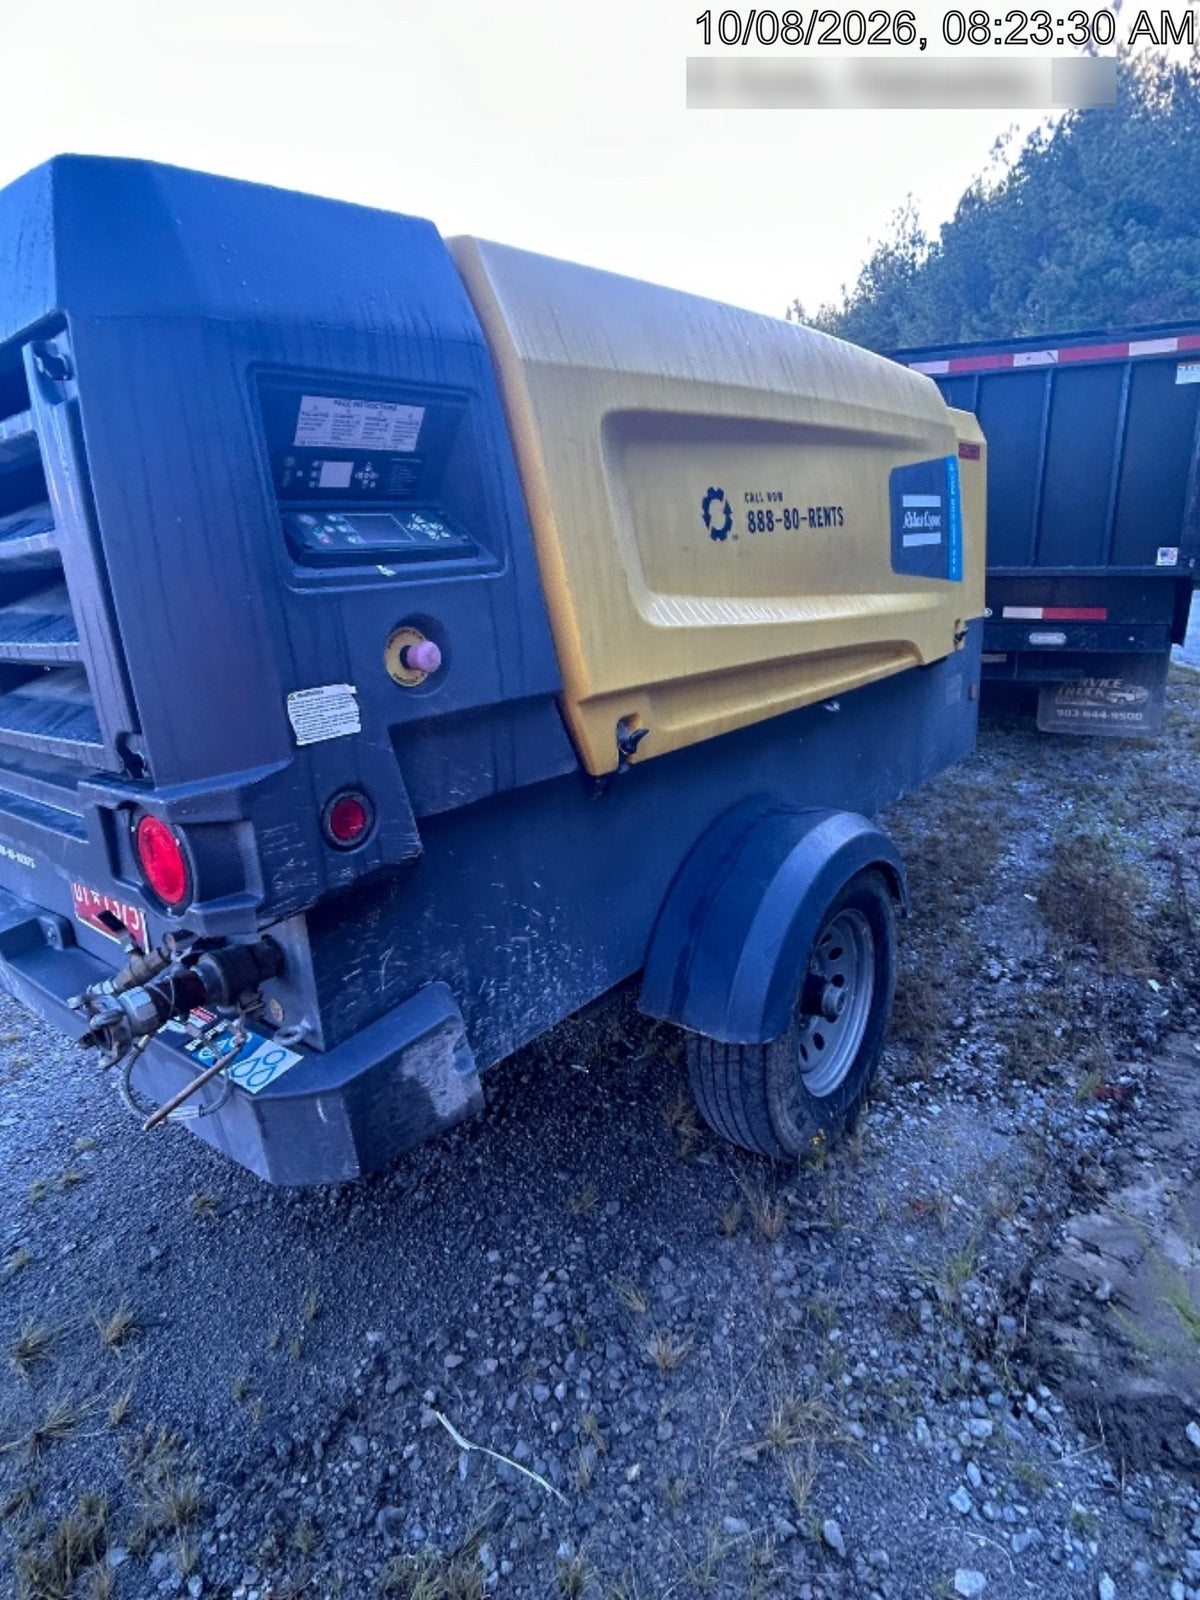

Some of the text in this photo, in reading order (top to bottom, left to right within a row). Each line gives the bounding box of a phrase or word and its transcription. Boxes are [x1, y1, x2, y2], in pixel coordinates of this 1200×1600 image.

[744, 491, 783, 504] CALL NOW
[747, 505, 844, 534] 888-80-RENTS
